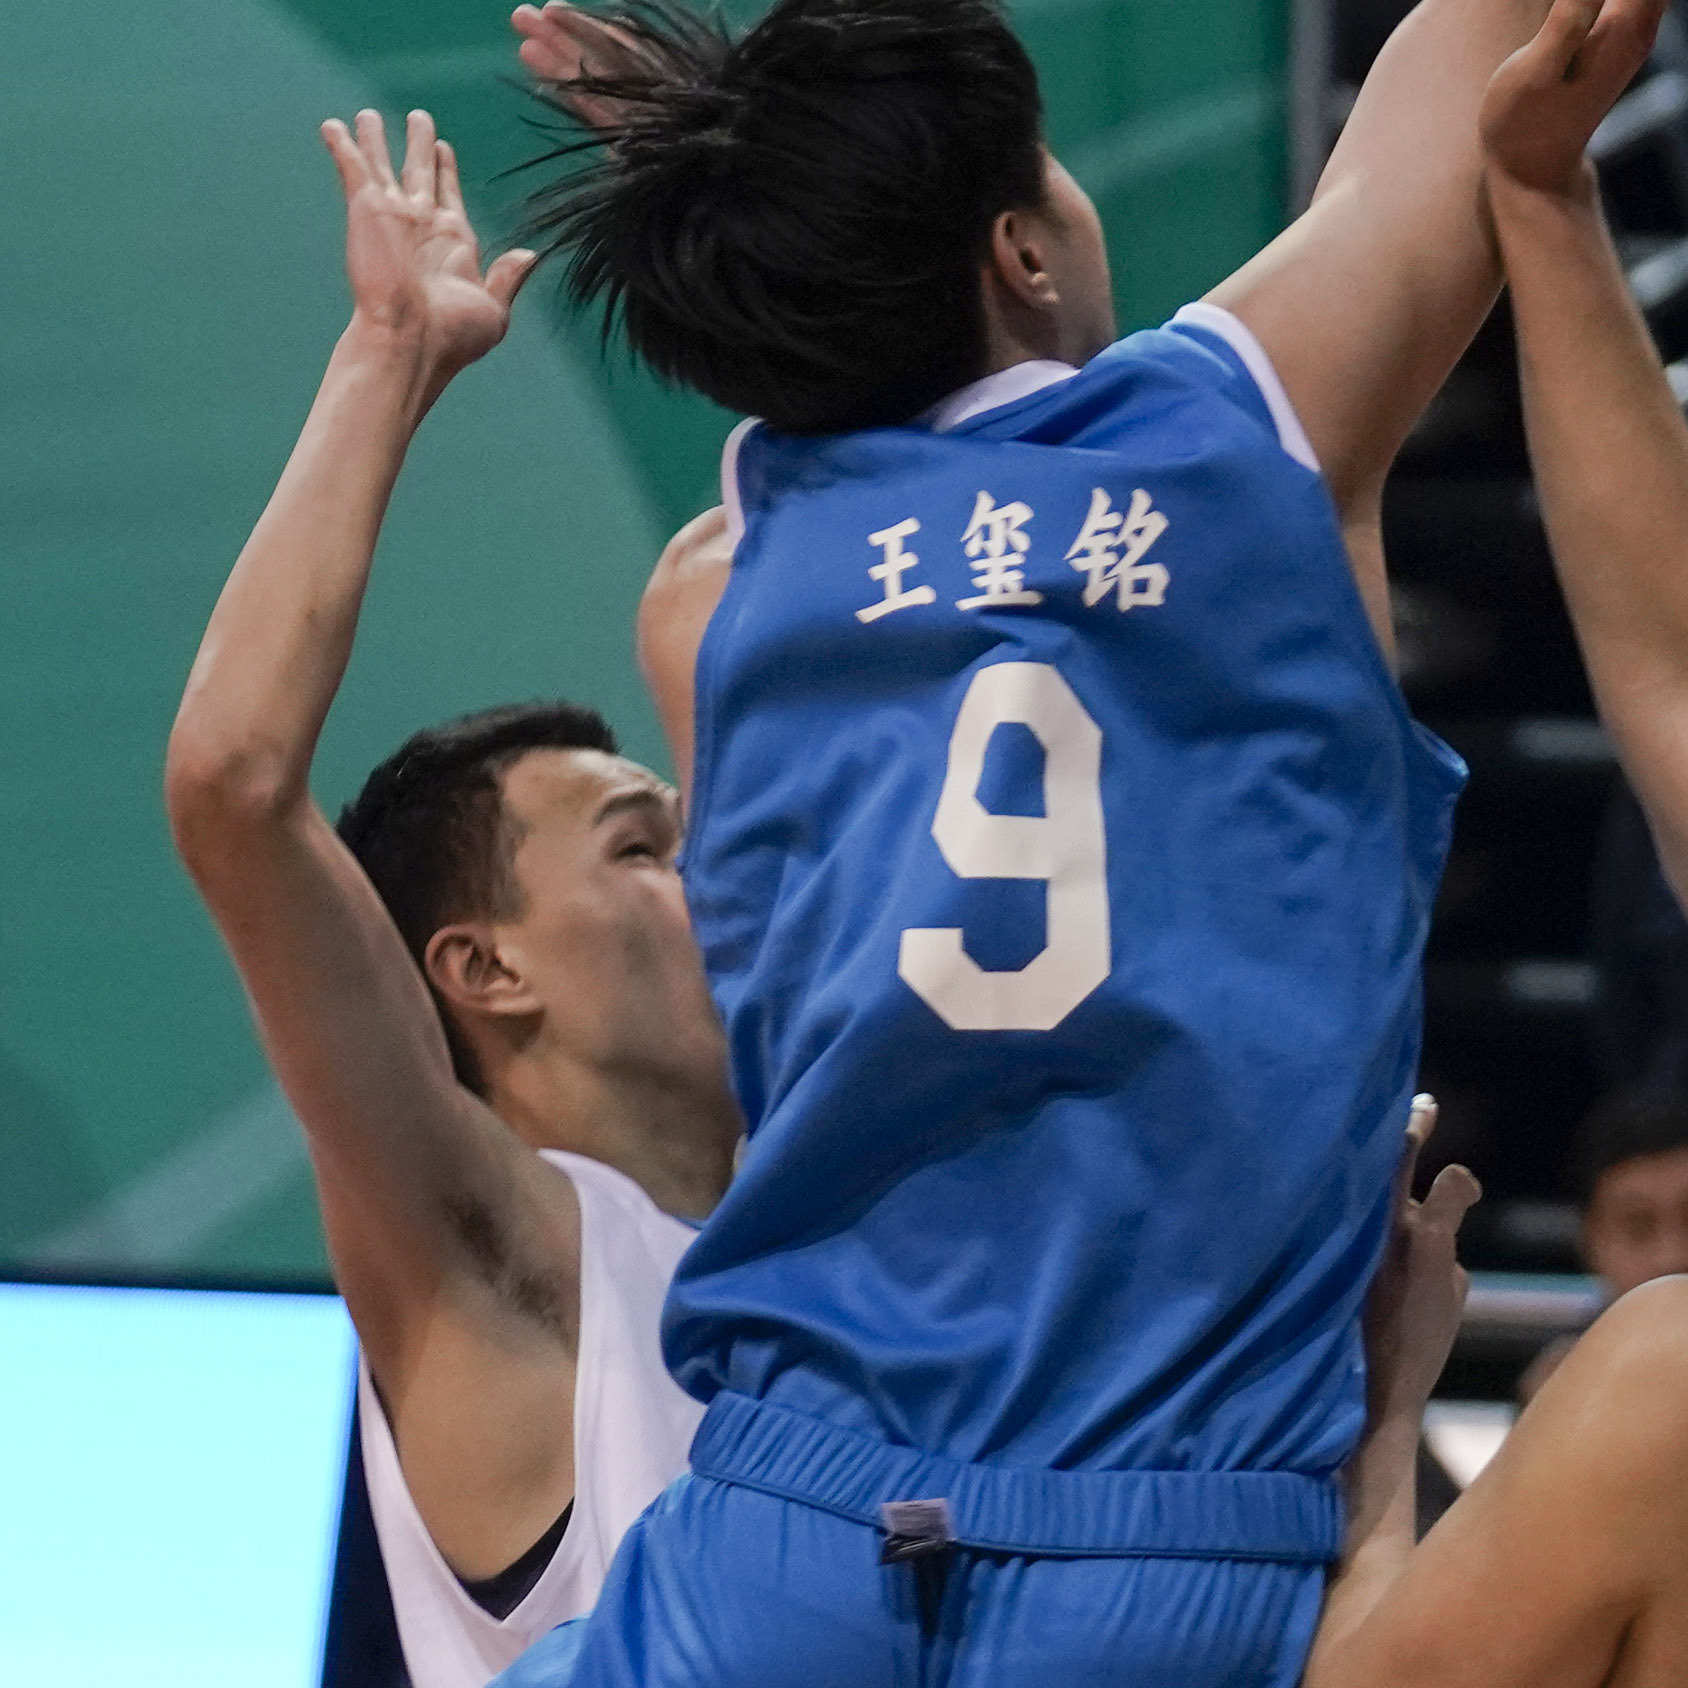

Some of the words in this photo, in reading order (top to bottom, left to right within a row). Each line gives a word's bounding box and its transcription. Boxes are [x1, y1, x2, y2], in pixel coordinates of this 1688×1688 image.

[854, 486, 1171, 624] 王玺铭
[898, 661, 1112, 1032] 9
